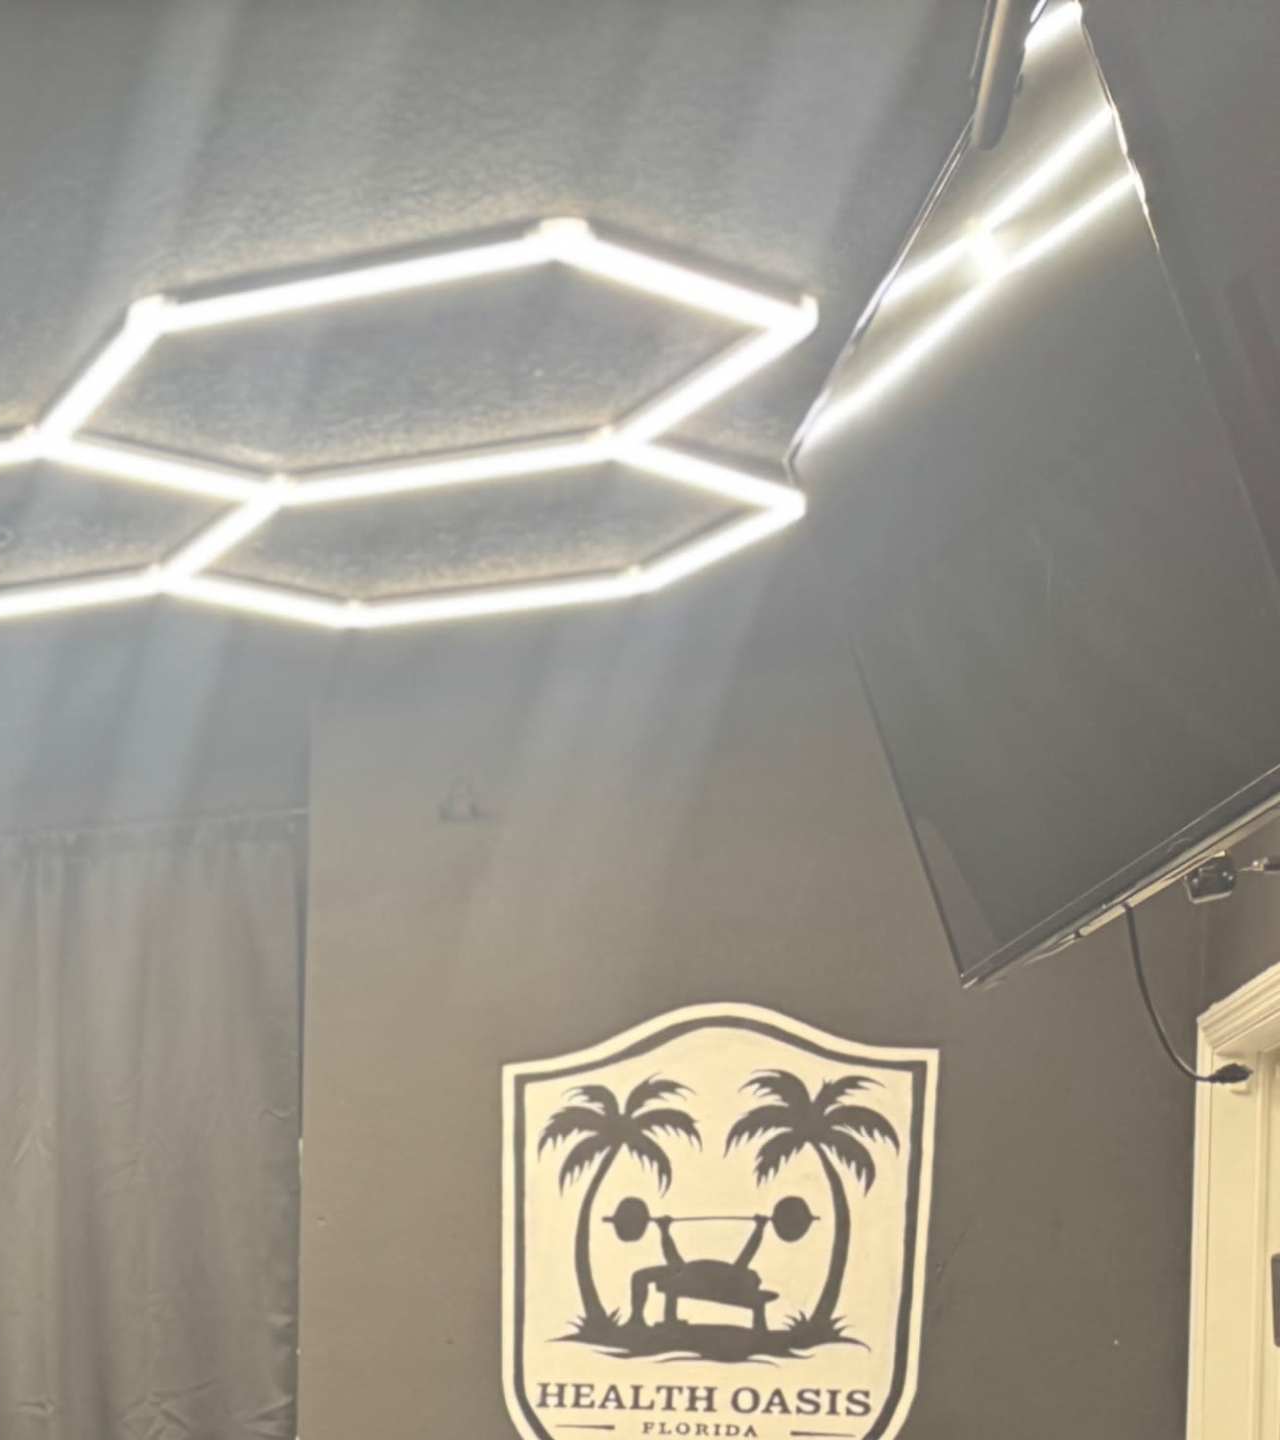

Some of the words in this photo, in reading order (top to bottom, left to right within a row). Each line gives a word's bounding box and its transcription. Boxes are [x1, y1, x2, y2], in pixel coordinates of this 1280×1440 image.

[536, 1382, 717, 1412] HEALTH
[730, 1387, 872, 1417] OASIS
[642, 1421, 758, 1438] FLORIDA
